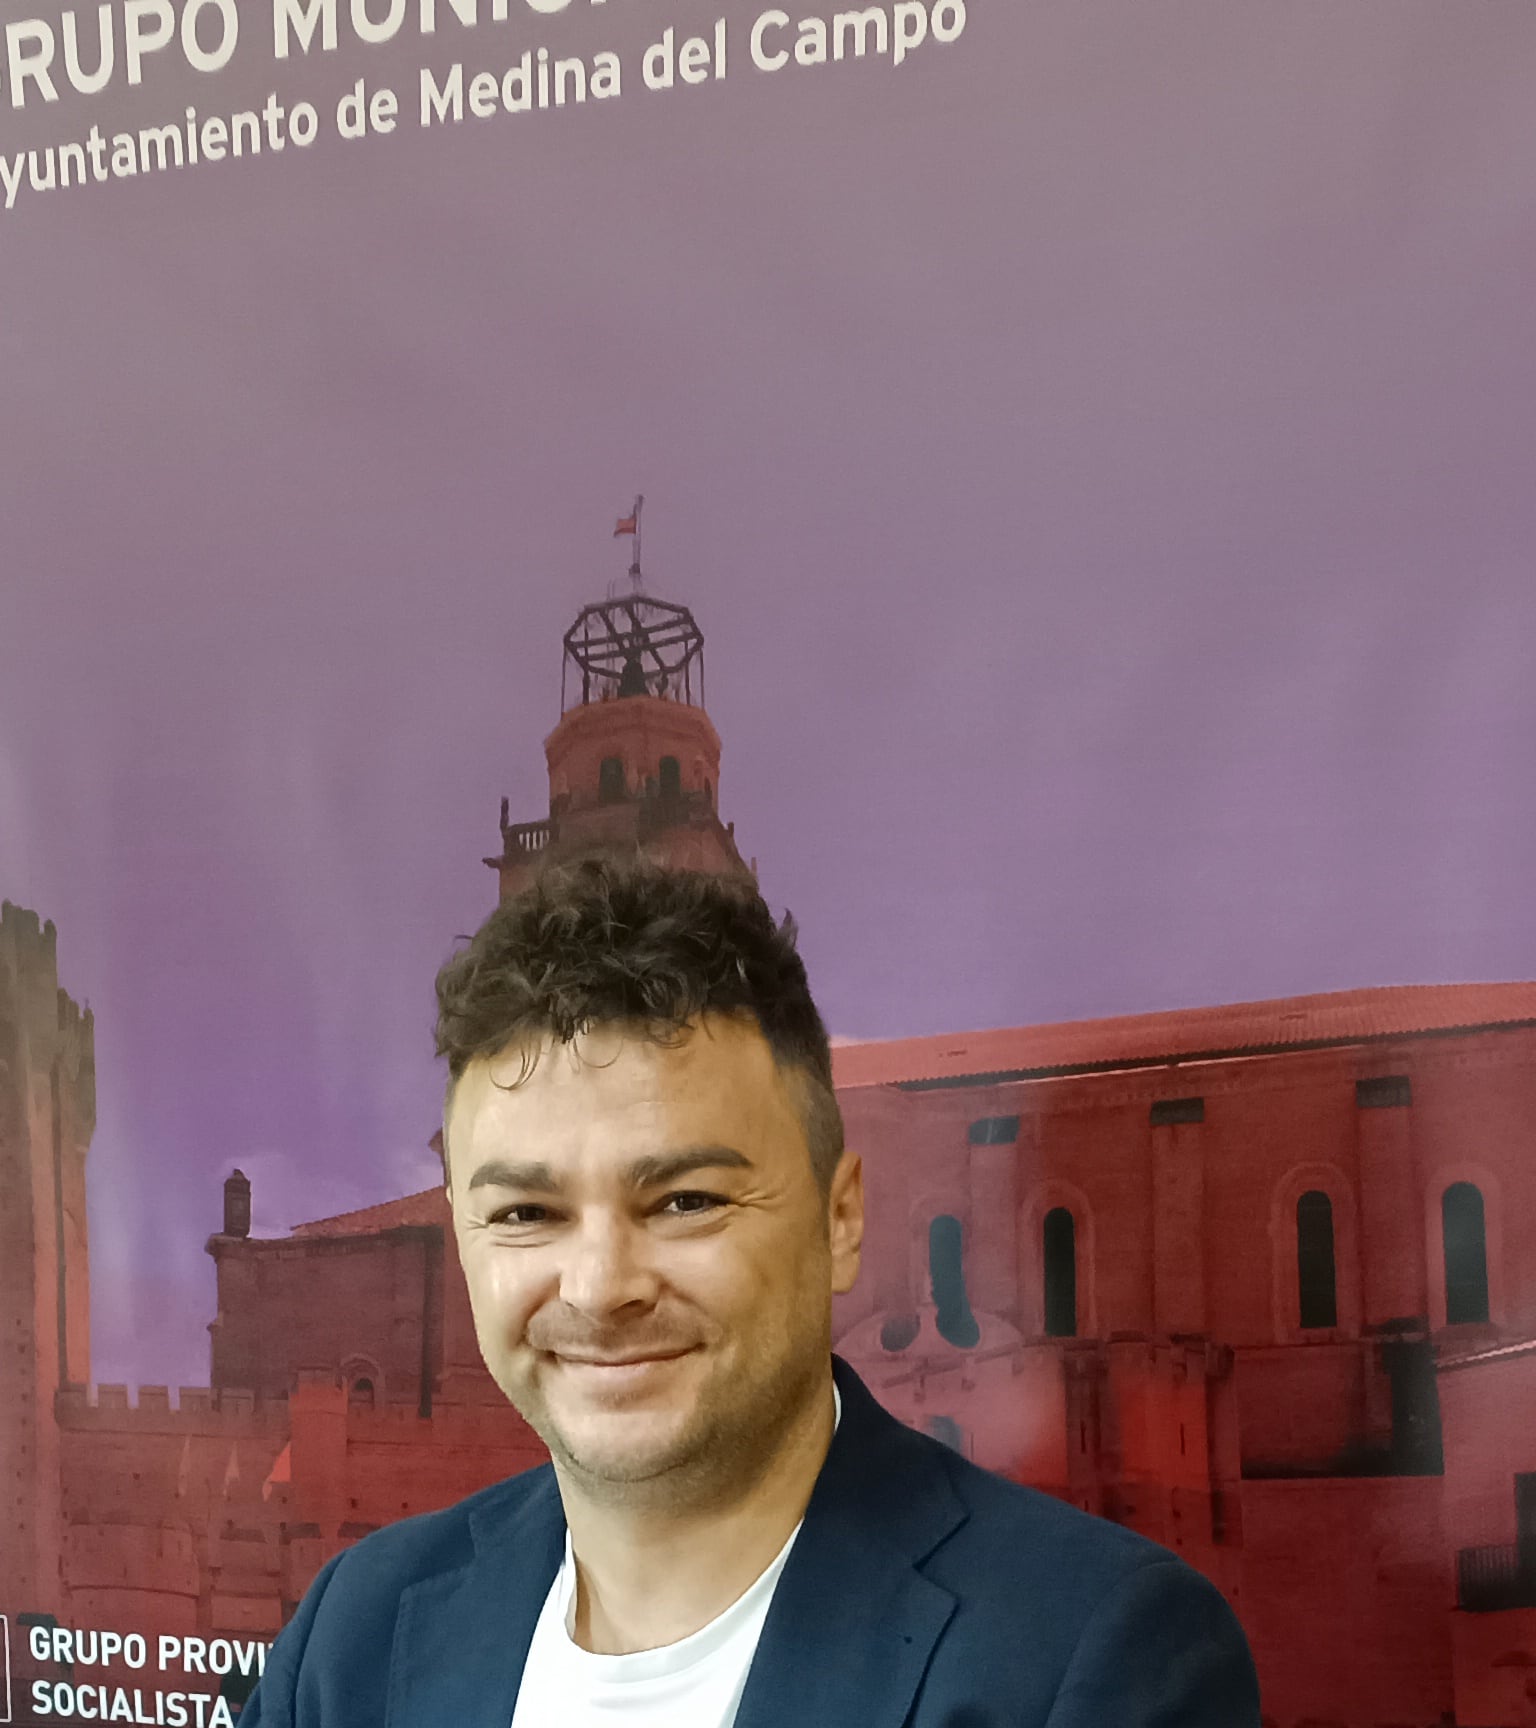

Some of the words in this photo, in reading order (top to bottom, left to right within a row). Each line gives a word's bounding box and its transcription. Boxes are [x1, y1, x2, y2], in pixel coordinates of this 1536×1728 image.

[336, 78, 400, 139] de
[419, 45, 622, 128] Medina
[641, 15, 727, 90] del
[750, 0, 967, 72] Campo
[29, 1625, 147, 1669] GRUPO
[158, 1634, 275, 1678] PROVI
